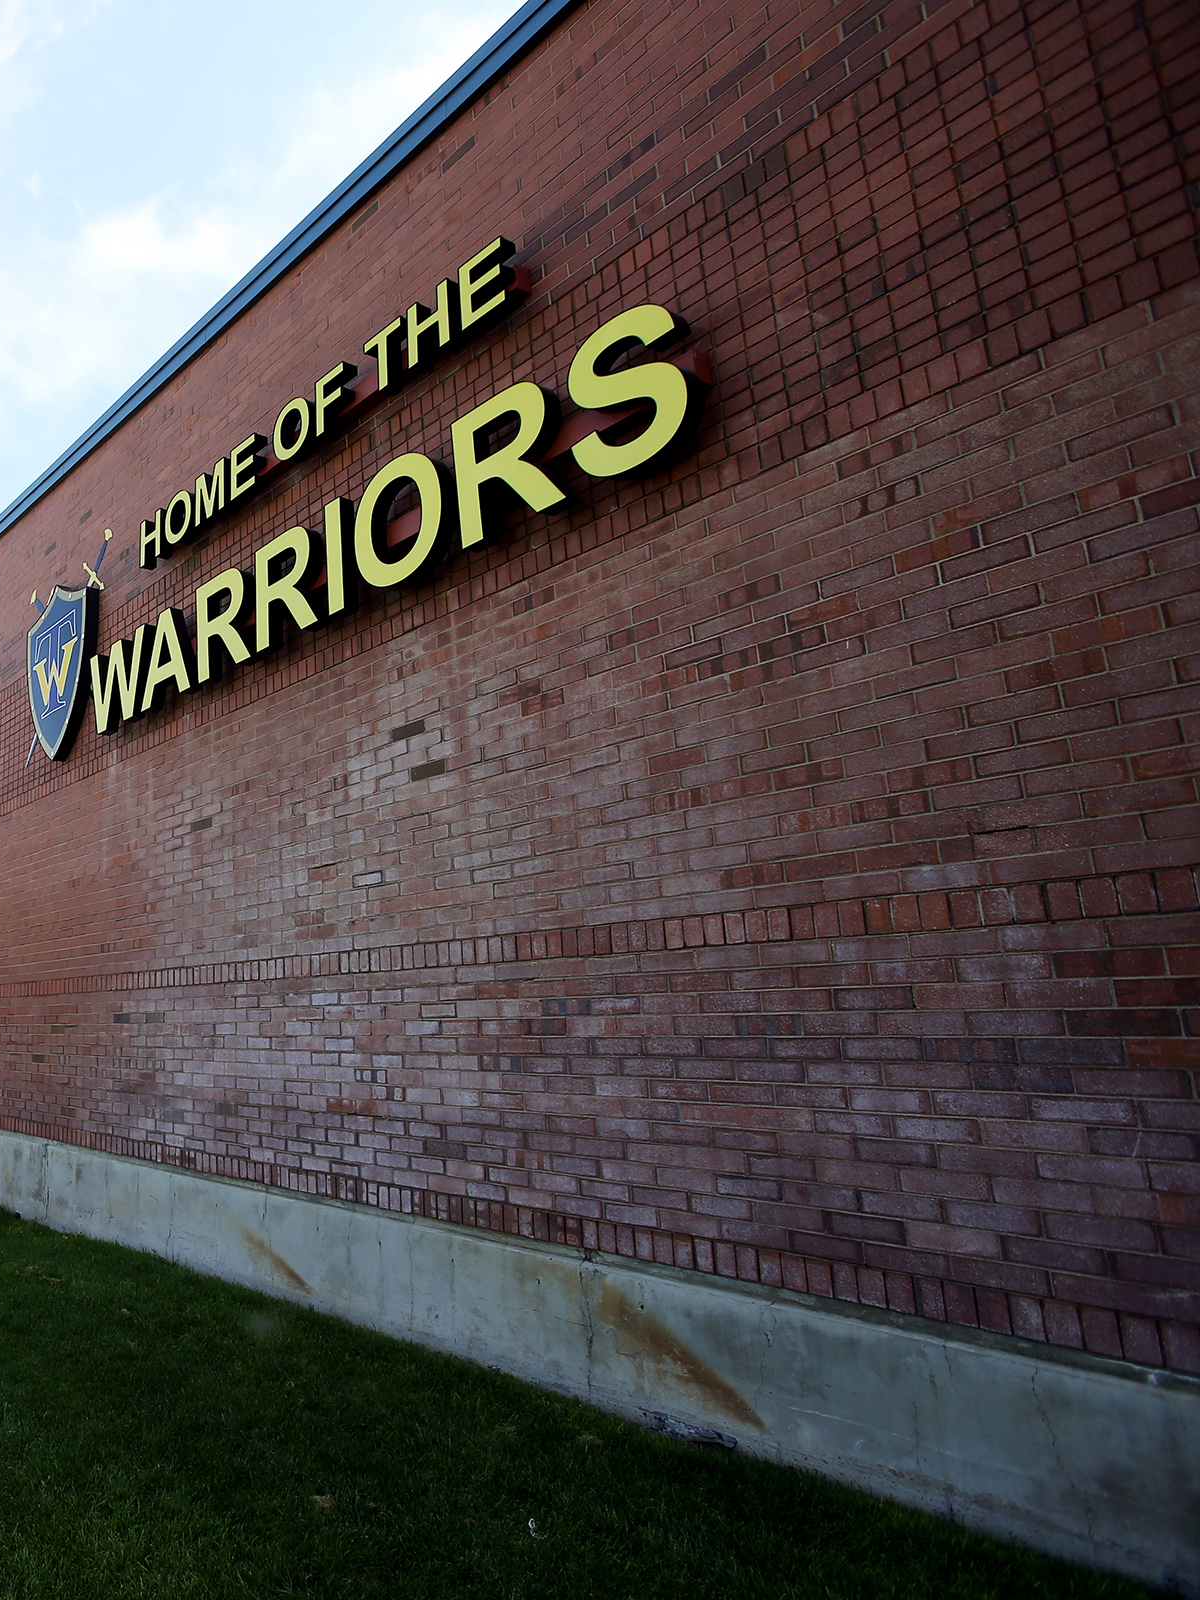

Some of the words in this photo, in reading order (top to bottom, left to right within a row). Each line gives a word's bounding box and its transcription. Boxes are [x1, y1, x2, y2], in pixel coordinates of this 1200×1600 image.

[90, 304, 688, 735] WARRIORS
[140, 436, 257, 568] HOME
[272, 363, 345, 460] OF
[363, 237, 506, 391] THE
